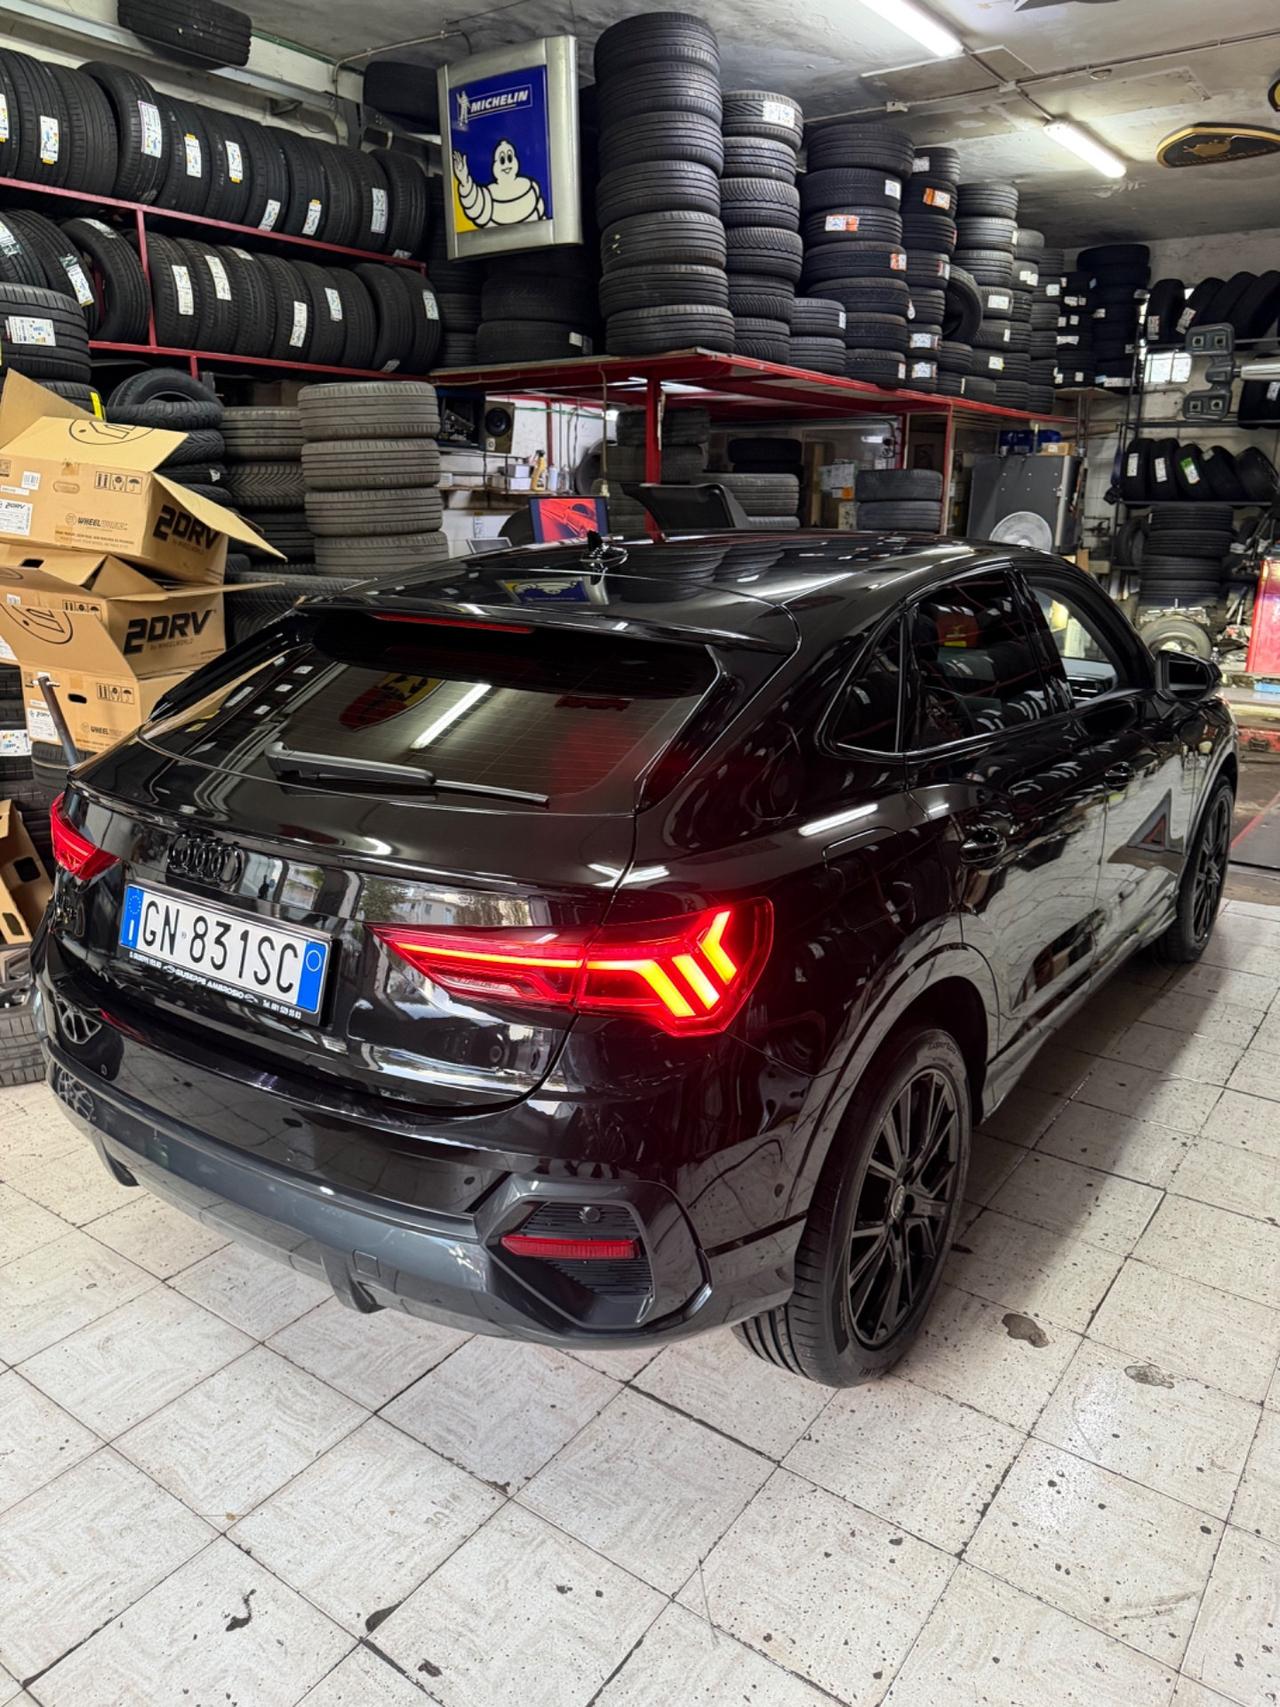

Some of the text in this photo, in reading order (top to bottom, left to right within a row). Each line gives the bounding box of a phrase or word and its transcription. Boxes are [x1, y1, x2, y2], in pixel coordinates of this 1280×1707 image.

[471, 90, 528, 113] MICHELIN
[152, 504, 221, 550] 2DRV
[142, 900, 299, 994] GN 831SC
[207, 980, 244, 999] AMBROSIO
